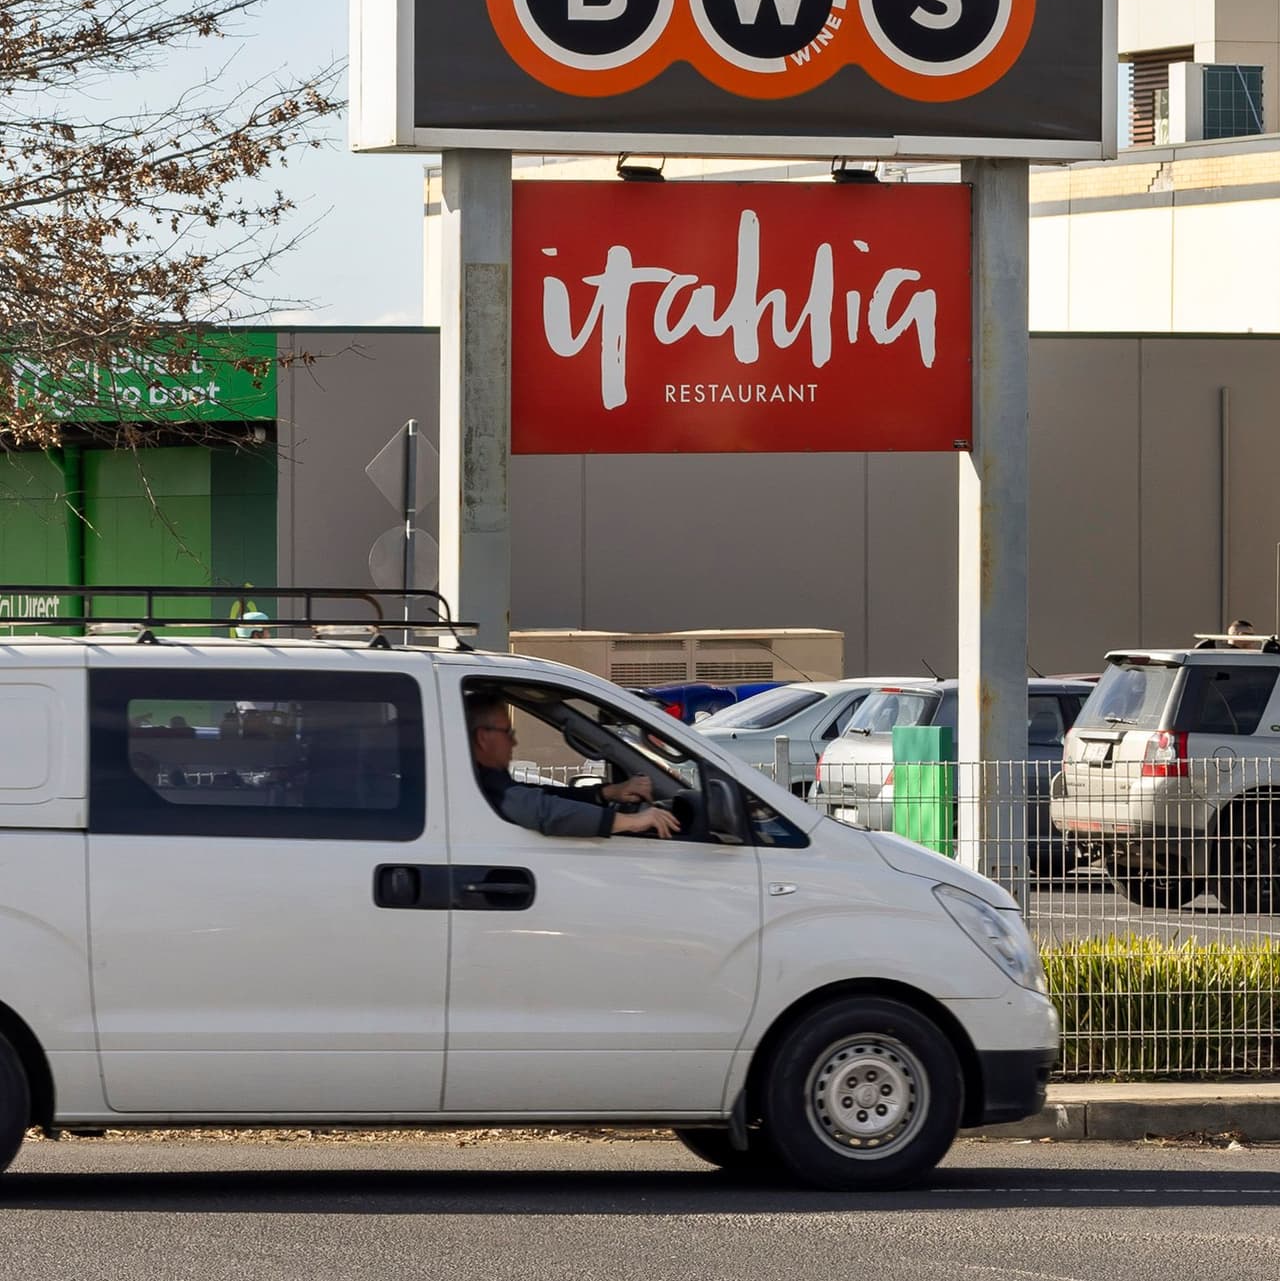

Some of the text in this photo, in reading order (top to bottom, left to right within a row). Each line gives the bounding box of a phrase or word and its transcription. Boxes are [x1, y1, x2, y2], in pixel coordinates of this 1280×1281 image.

[790, 14, 842, 68] WINE
[541, 209, 937, 410] itahlia
[665, 383, 819, 403] RESTAURANT
[18, 593, 60, 619] Direct
